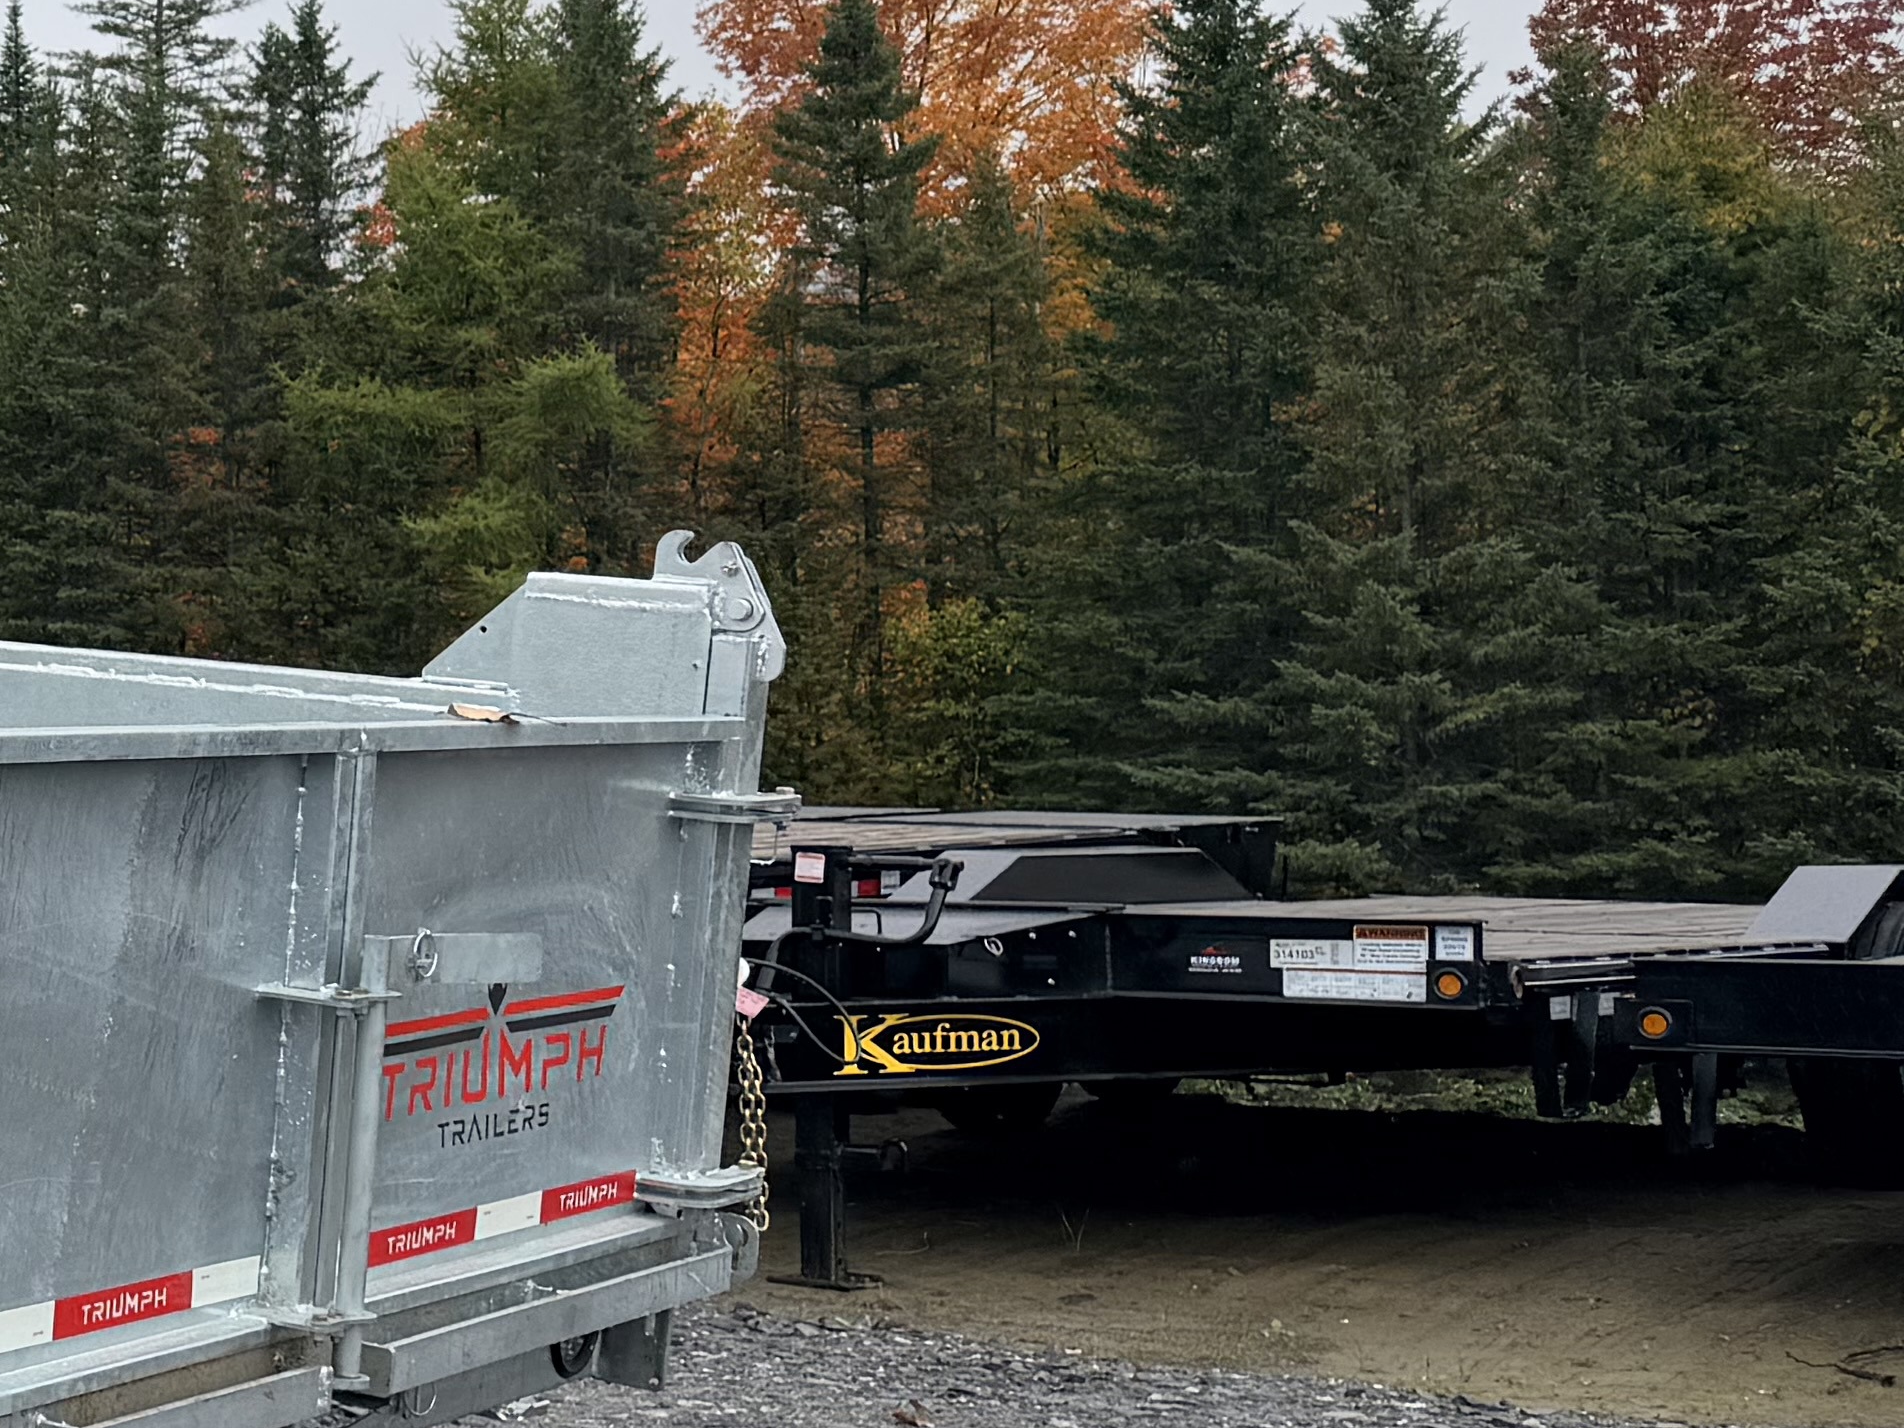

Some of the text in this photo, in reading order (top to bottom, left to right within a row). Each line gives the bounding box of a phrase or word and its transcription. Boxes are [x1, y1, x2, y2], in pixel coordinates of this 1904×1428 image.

[833, 1013, 1022, 1075] Kaufman
[382, 1024, 607, 1121] TRIUMPH
[437, 1103, 550, 1149] TRAILERS
[560, 1182, 618, 1212] TRIUMPH
[387, 1221, 457, 1255] TRIUMPH
[82, 1287, 167, 1325] TRIUMPH
